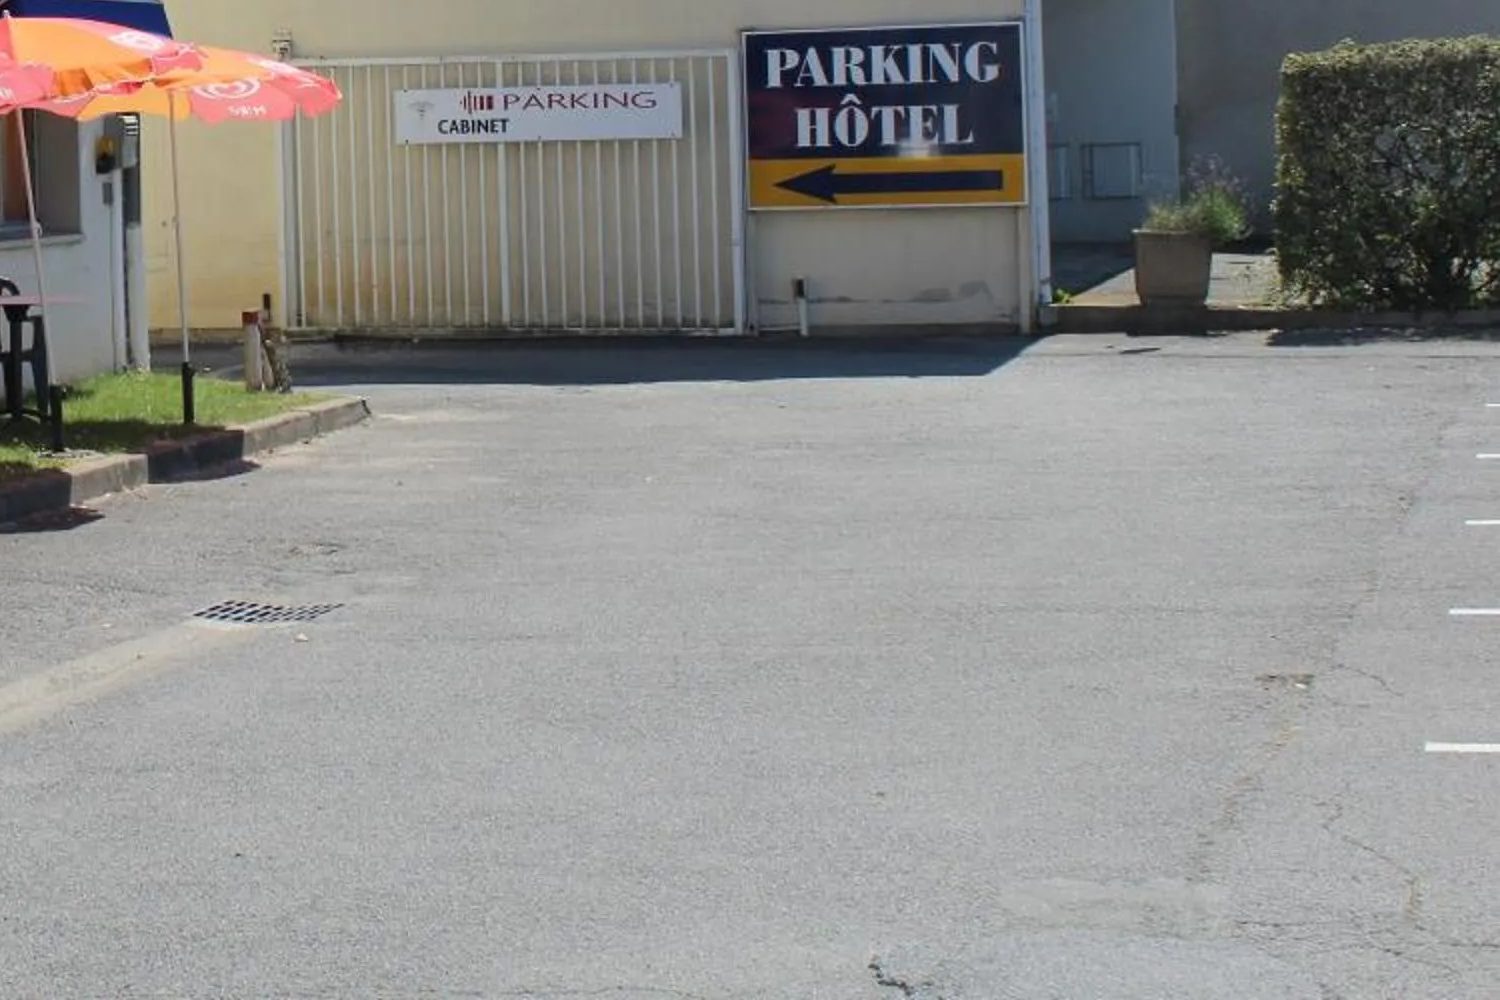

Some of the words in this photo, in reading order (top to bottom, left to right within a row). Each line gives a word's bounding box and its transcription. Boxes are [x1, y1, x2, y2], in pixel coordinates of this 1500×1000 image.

[765, 41, 1000, 88] PARKING
[503, 91, 657, 111] PARKING
[437, 118, 510, 135] CABINET
[795, 93, 974, 147] HÔTEL
